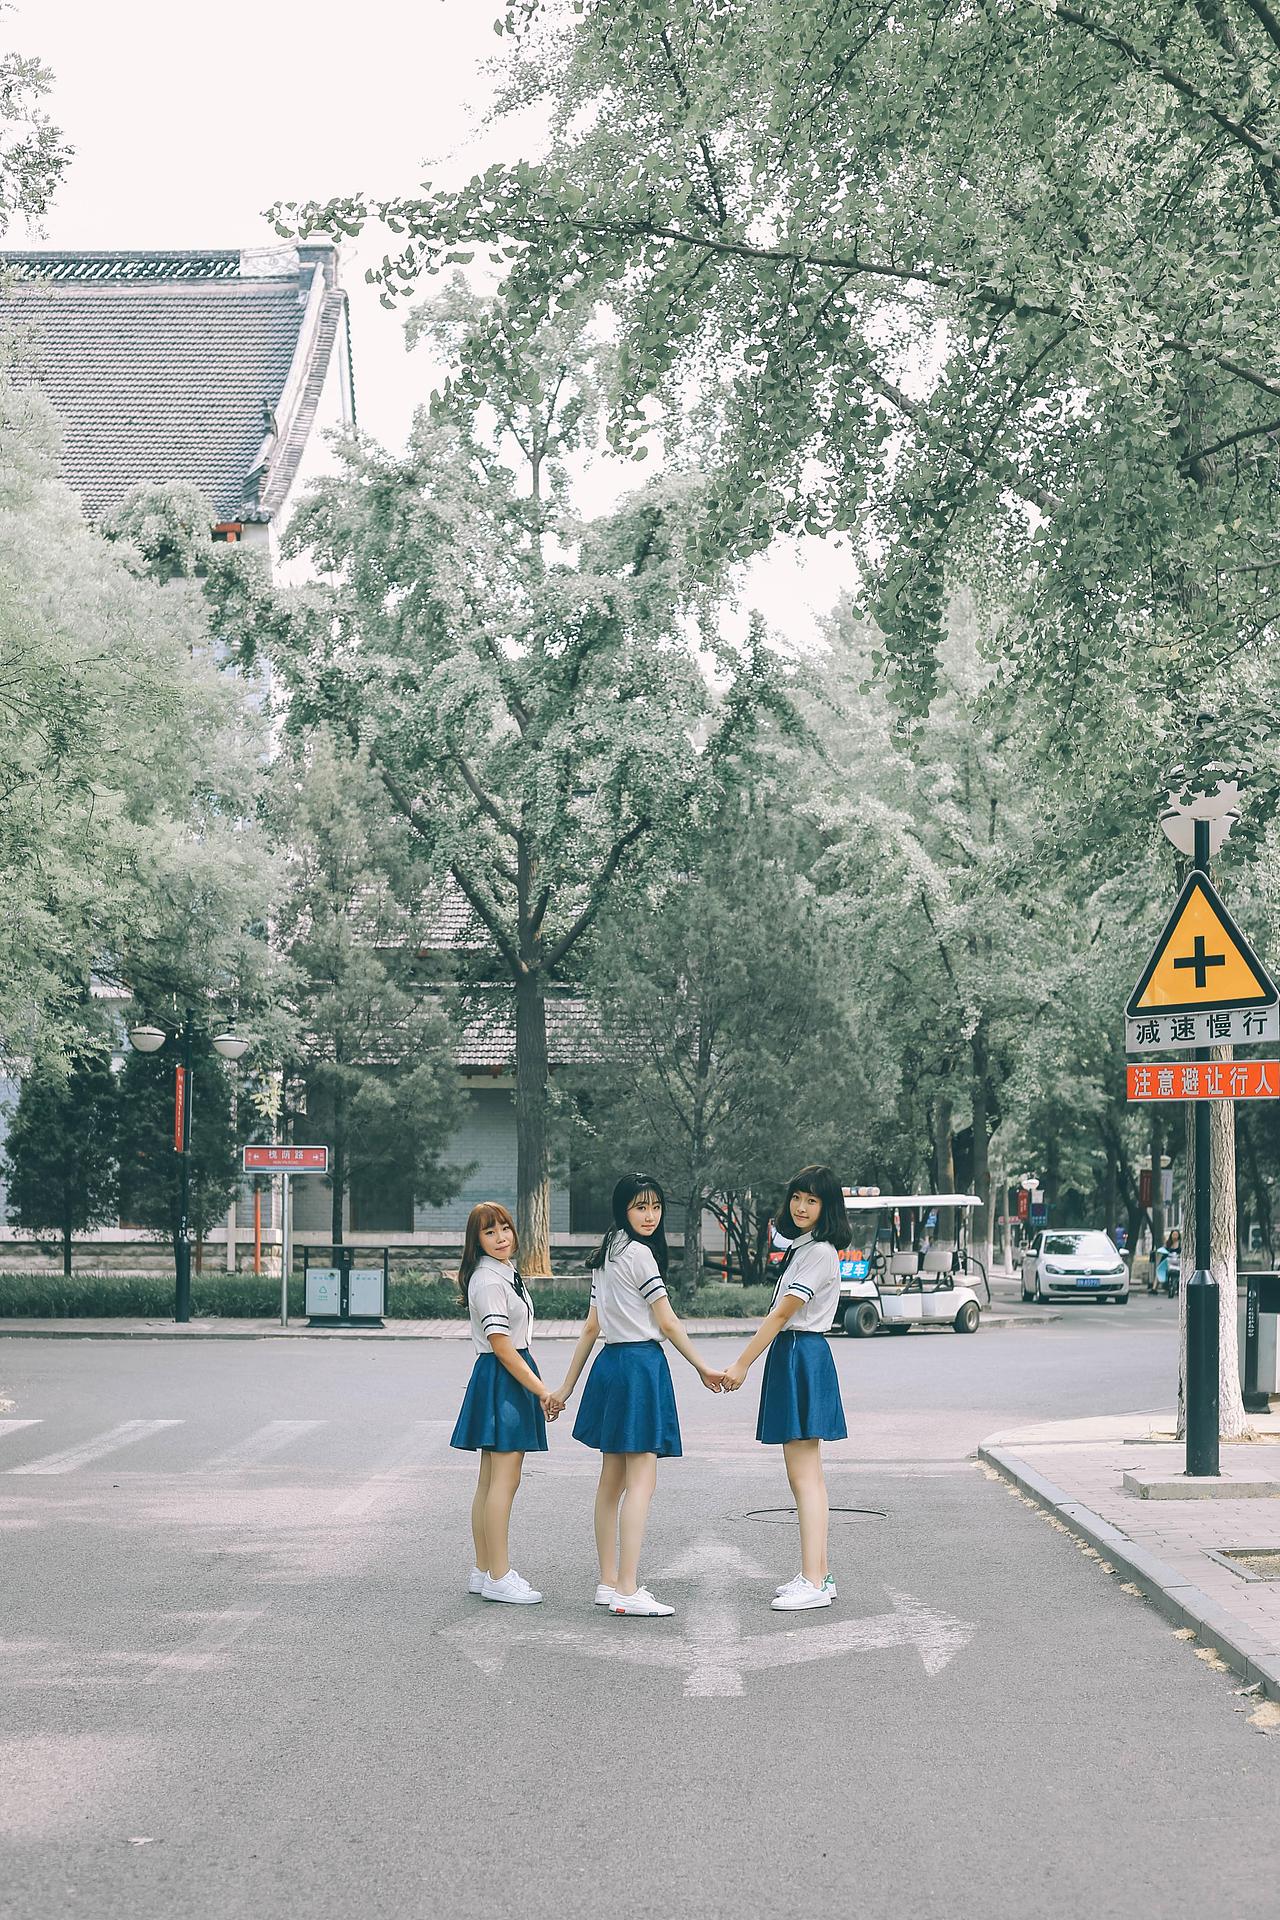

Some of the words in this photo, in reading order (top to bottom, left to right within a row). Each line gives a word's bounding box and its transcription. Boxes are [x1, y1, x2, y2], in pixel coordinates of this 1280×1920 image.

[1136, 1011, 1267, 1044] 减速慢行
[1135, 1065, 1273, 1097] 注意避让行人
